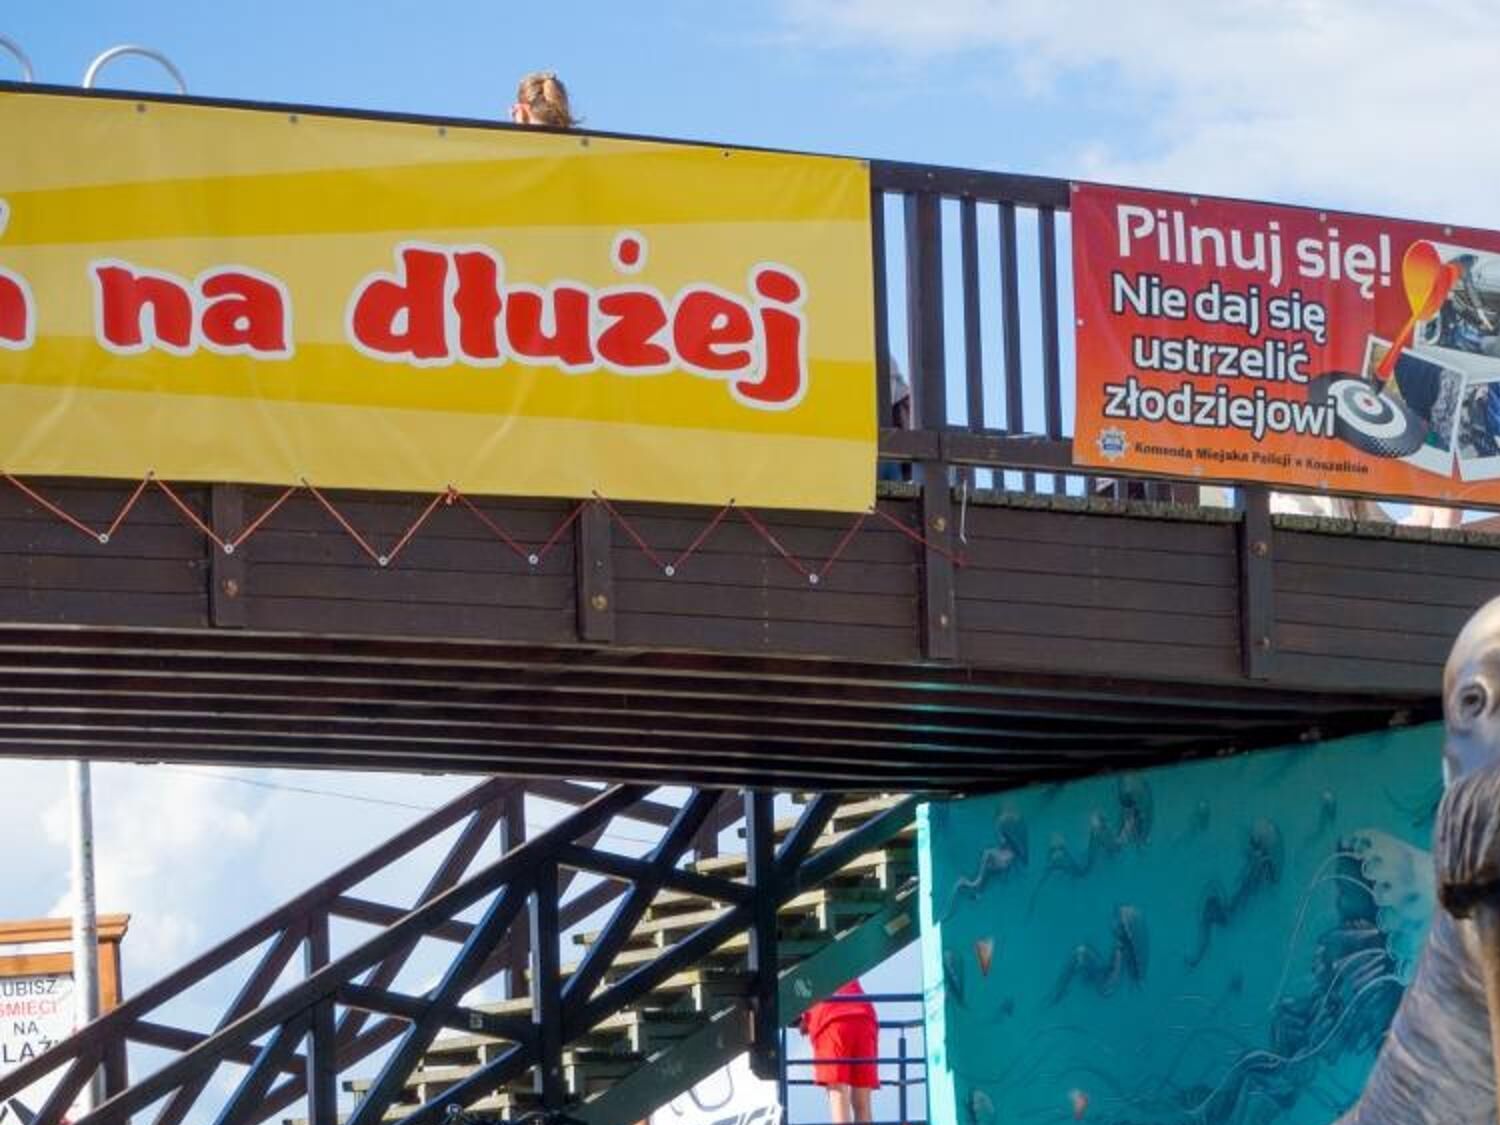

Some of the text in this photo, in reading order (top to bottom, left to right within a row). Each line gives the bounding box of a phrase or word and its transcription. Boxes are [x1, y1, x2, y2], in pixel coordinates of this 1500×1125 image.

[1116, 203, 1392, 300] Pilnuj się!
[92, 261, 290, 354] na
[348, 234, 806, 406] dłużej
[1111, 271, 1328, 345] Nie daj się
[1132, 335, 1312, 385] ustrzelić
[1103, 376, 1336, 441] złodziejowi
[0, 978, 57, 997] UBISZ
[13, 1021, 39, 1036] NA
